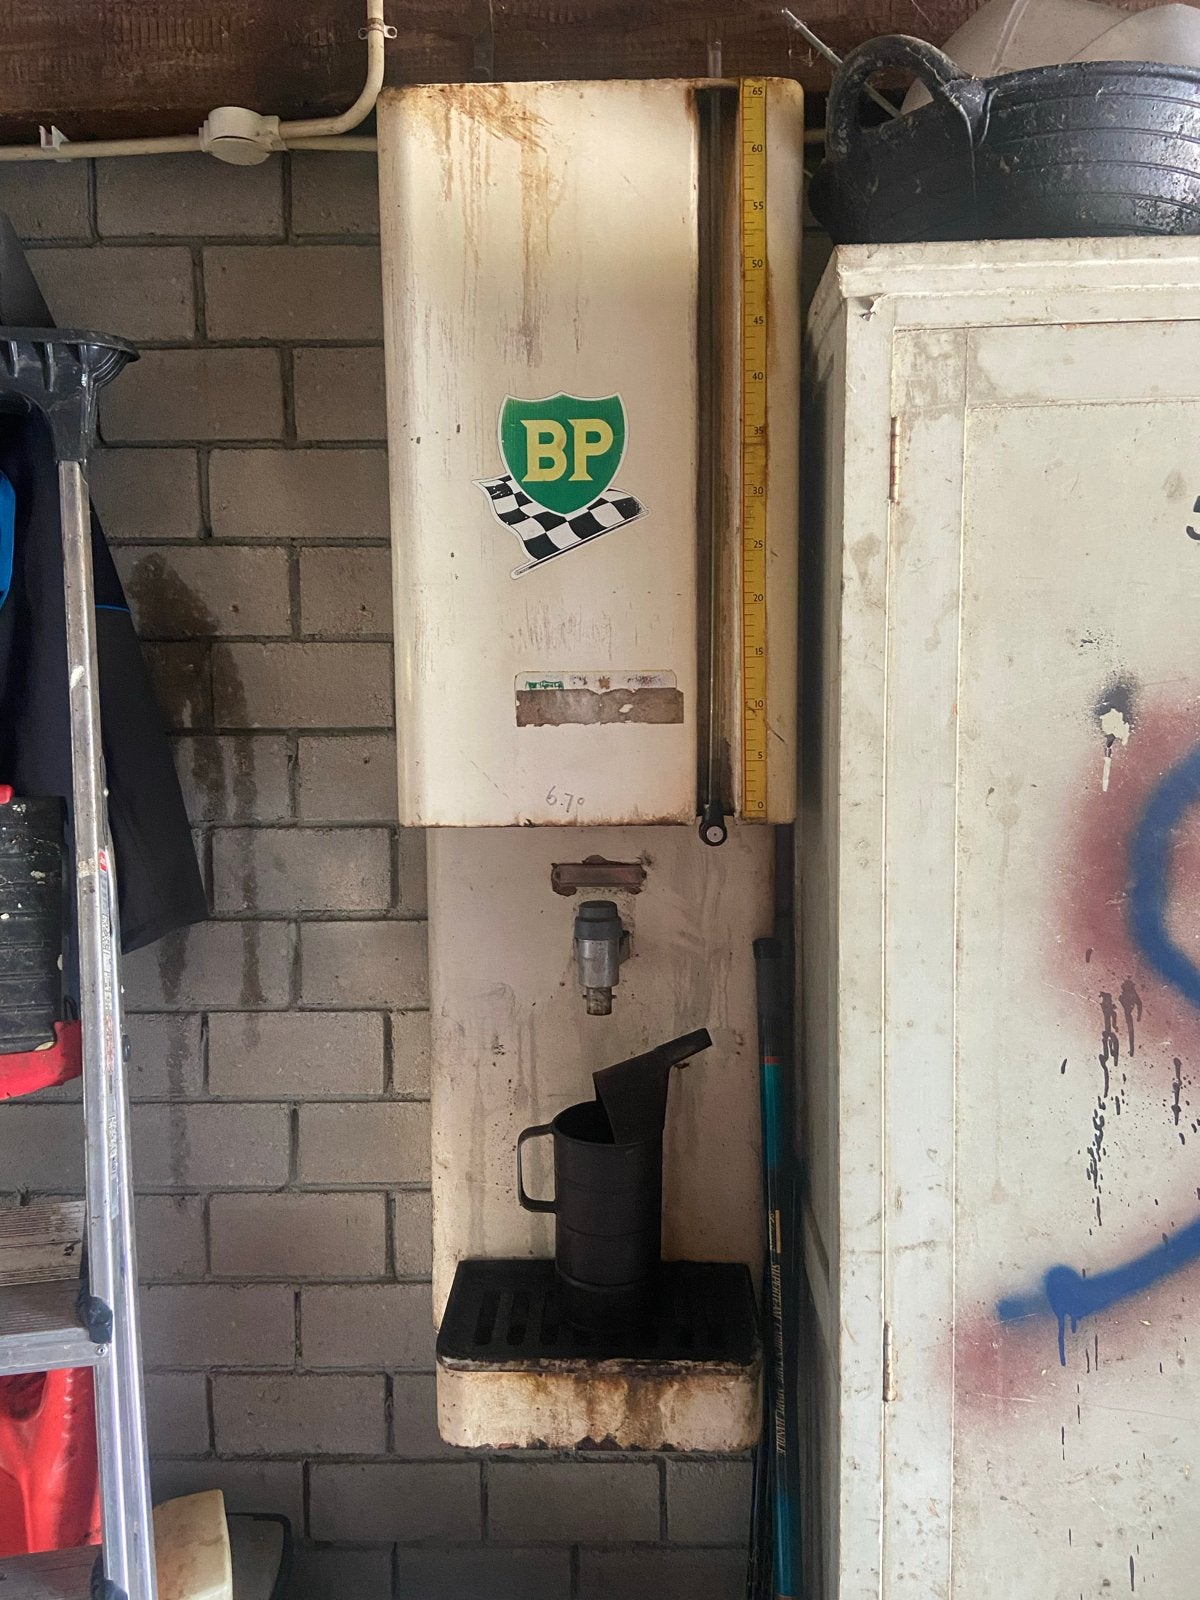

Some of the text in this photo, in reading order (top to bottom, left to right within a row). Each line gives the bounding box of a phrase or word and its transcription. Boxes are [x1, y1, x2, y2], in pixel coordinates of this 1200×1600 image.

[752, 87, 763, 95] 65
[751, 144, 763, 152] 60
[753, 202, 764, 210] 55
[752, 259, 763, 268] 50
[753, 316, 764, 324] 45
[752, 372, 764, 380] 40
[754, 427, 764, 435] 35
[520, 418, 614, 482] BP
[752, 487, 764, 495] 30
[753, 540, 763, 548] 25
[753, 594, 763, 602] 20
[755, 647, 764, 655] 15
[755, 700, 764, 708] 10
[757, 751, 763, 759] 5
[757, 801, 764, 809] 0
